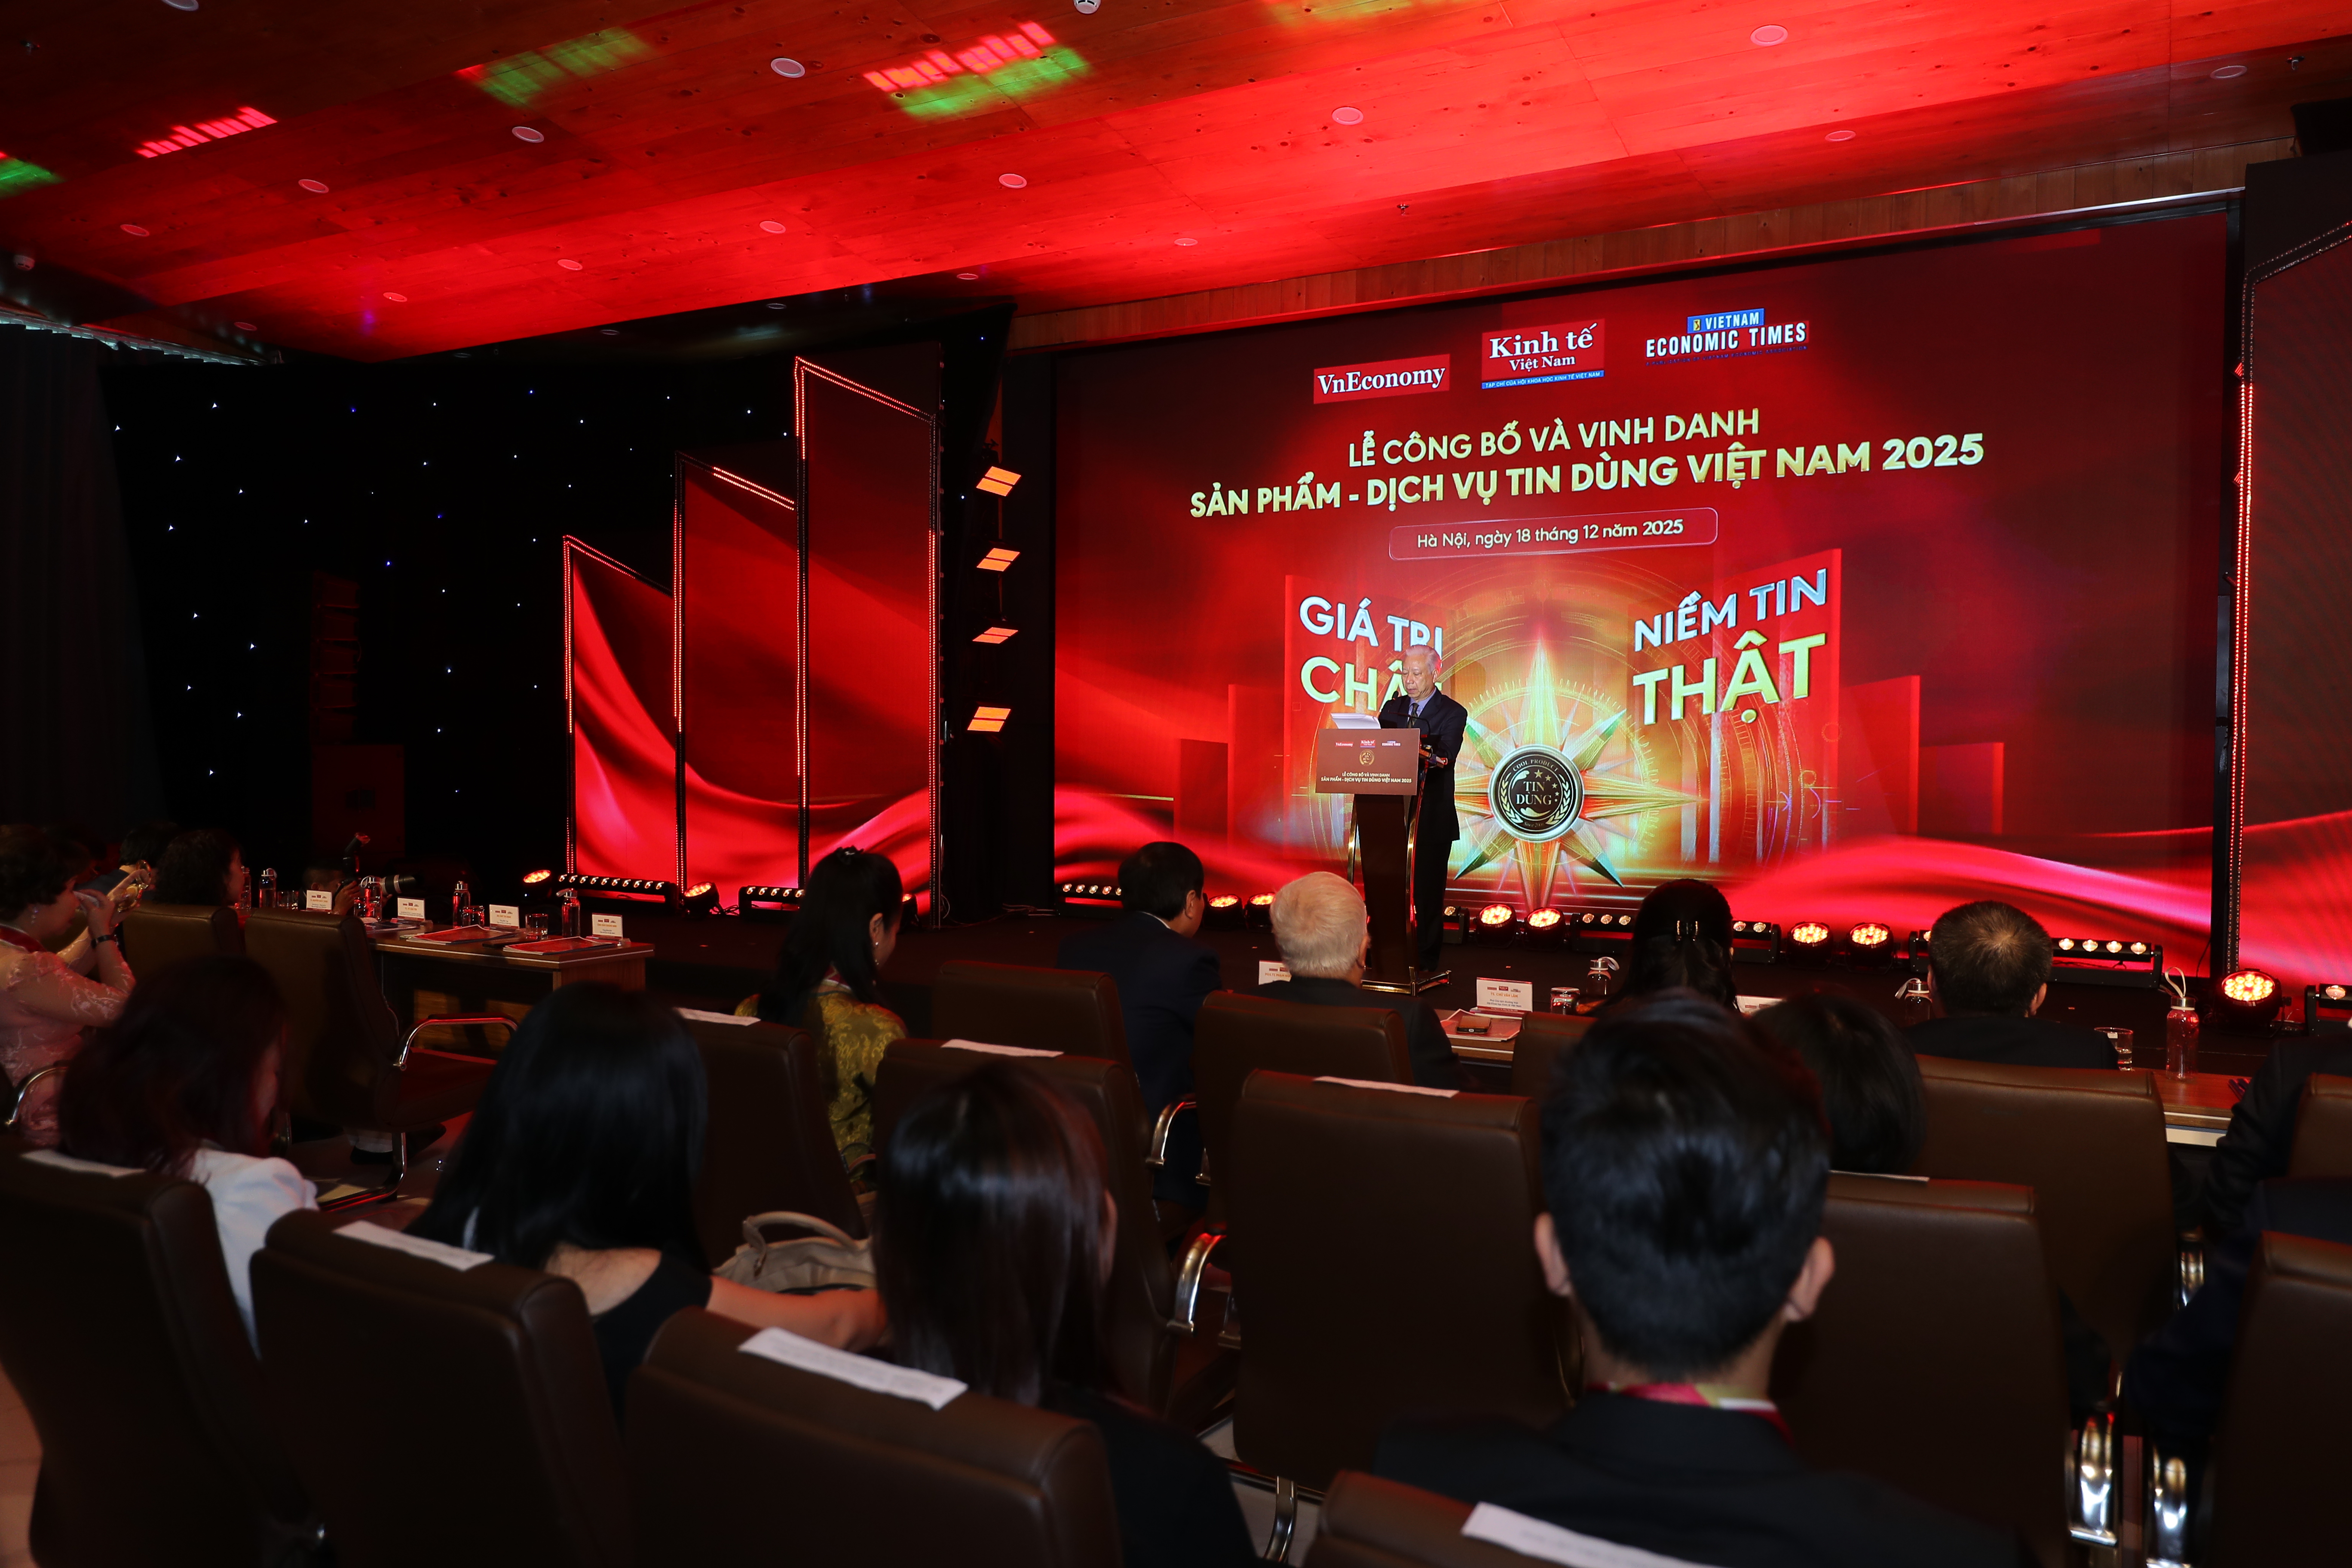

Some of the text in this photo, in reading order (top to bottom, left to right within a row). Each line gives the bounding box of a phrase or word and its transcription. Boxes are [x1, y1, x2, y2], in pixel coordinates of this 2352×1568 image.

[1705, 312, 1759, 330] VIETNAM
[1489, 323, 1597, 358] Kinh tế
[1646, 322, 1806, 357] ECONOMIC TIMES
[1509, 355, 1575, 372] Việt Nam
[1318, 368, 1446, 395] VnEconomy
[1349, 408, 1758, 467] LỄ CÔNG BỐ VÀ VINH DANH
[1191, 482, 1248, 518] SẢN
[1257, 472, 1341, 513] PHẨM
[1367, 474, 1443, 512] DỊCH
[1452, 470, 1498, 505] VỤ
[1505, 463, 1560, 496] TIN
[1571, 451, 1678, 492] DÙNG
[1687, 441, 1767, 489] VIỆT
[1776, 441, 1870, 478] NAM
[1882, 433, 1984, 471] 2025
[1418, 519, 1684, 549] Hà Nội, ngày 18 tháng 12 năm 2025
[1749, 568, 1826, 621] TIN
[1299, 596, 1378, 647] GIÁ
[1633, 630, 1826, 726] THẬT
[1513, 759, 1559, 772] COOL PRODUCT
[1516, 792, 1552, 805] DÙNG
[1523, 781, 1545, 791] TIN
